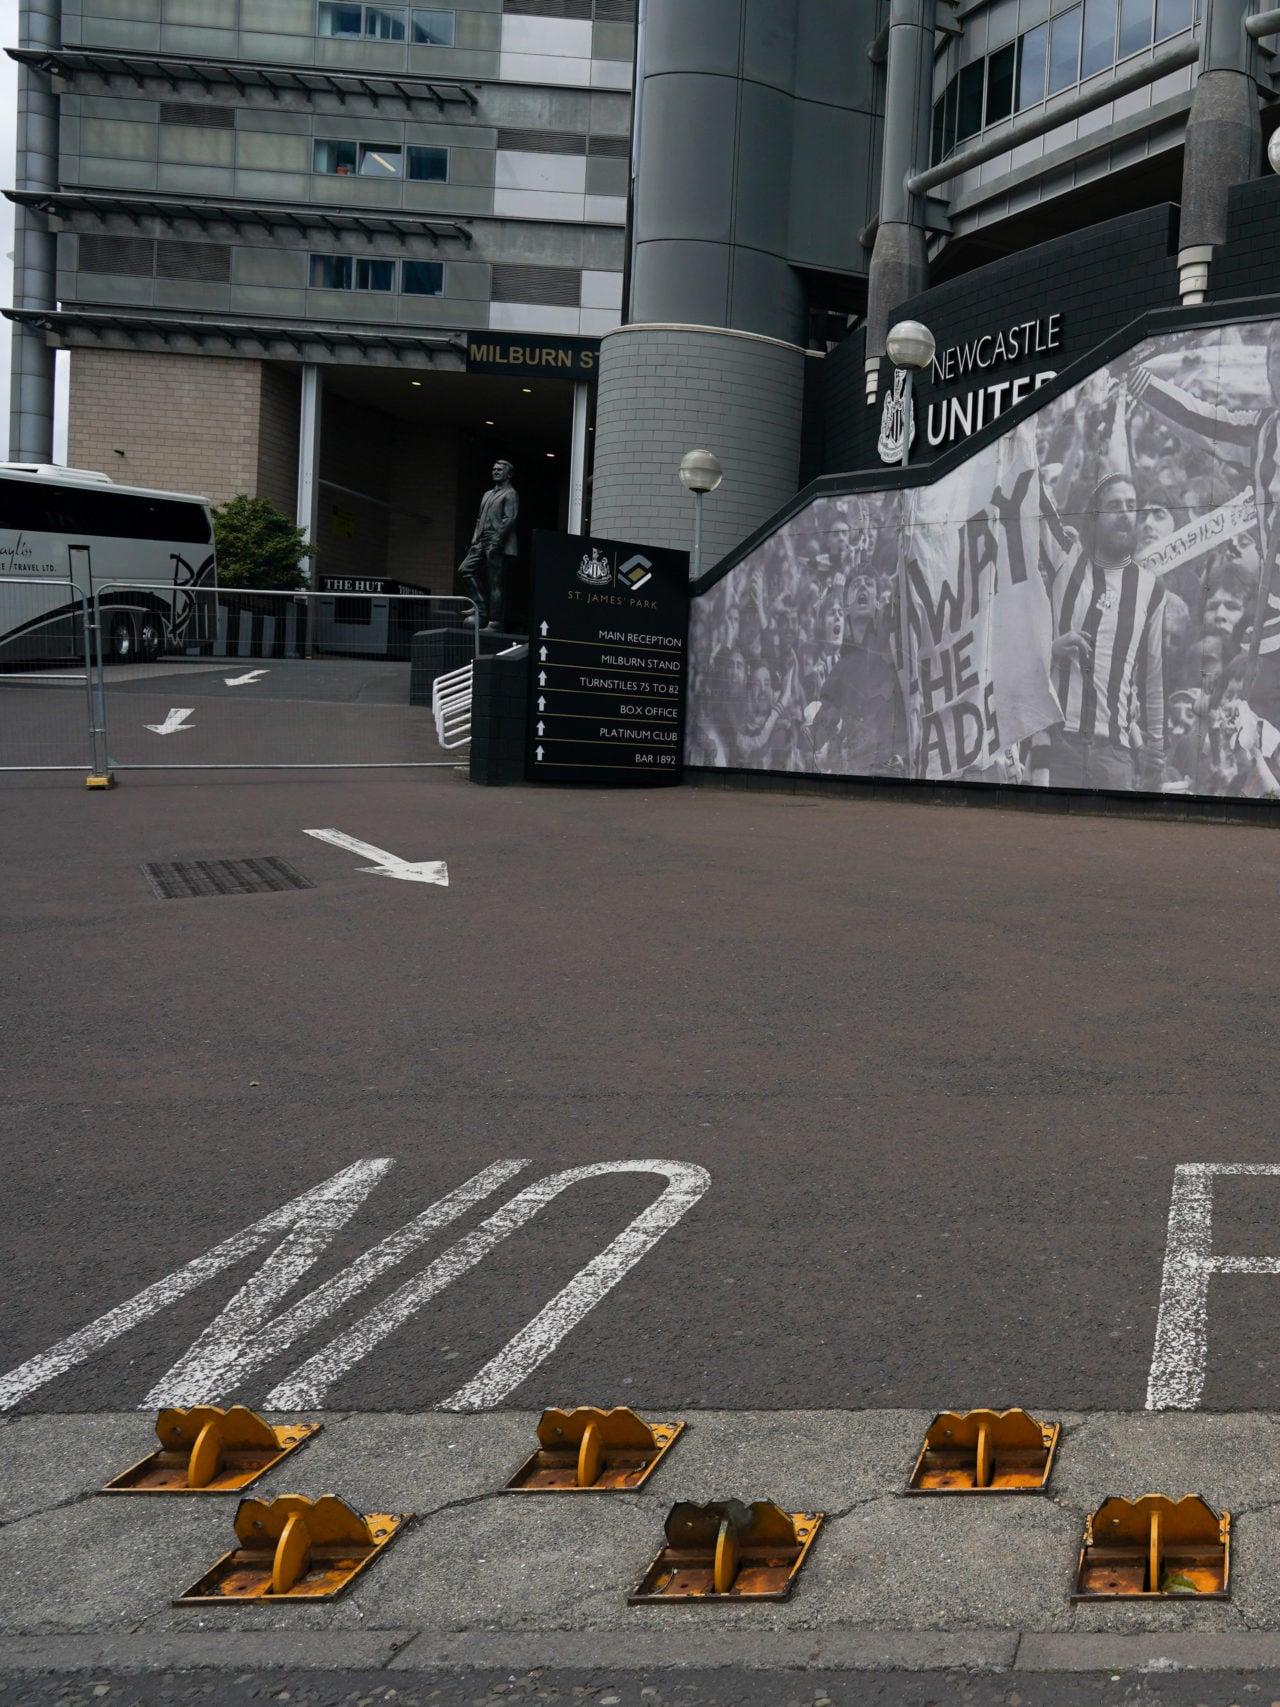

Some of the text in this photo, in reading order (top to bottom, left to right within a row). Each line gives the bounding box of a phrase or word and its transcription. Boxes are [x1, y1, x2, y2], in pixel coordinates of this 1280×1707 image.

[931, 313, 1060, 384] NEWCASTLE
[470, 343, 600, 369] MILBURN S
[14, 563, 39, 572] TRAVEL
[324, 579, 384, 593] THE HUT
[630, 598, 657, 609] PARK
[599, 630, 682, 647] MAIN RECEPTION
[601, 655, 681, 671] MILBURN STAND
[580, 677, 679, 694] TURNSTILES 75 TO 82
[620, 704, 678, 718] BOX OFFICE
[599, 728, 678, 741] PLATINUM CLUB
[635, 754, 676, 765] BAR 1892
